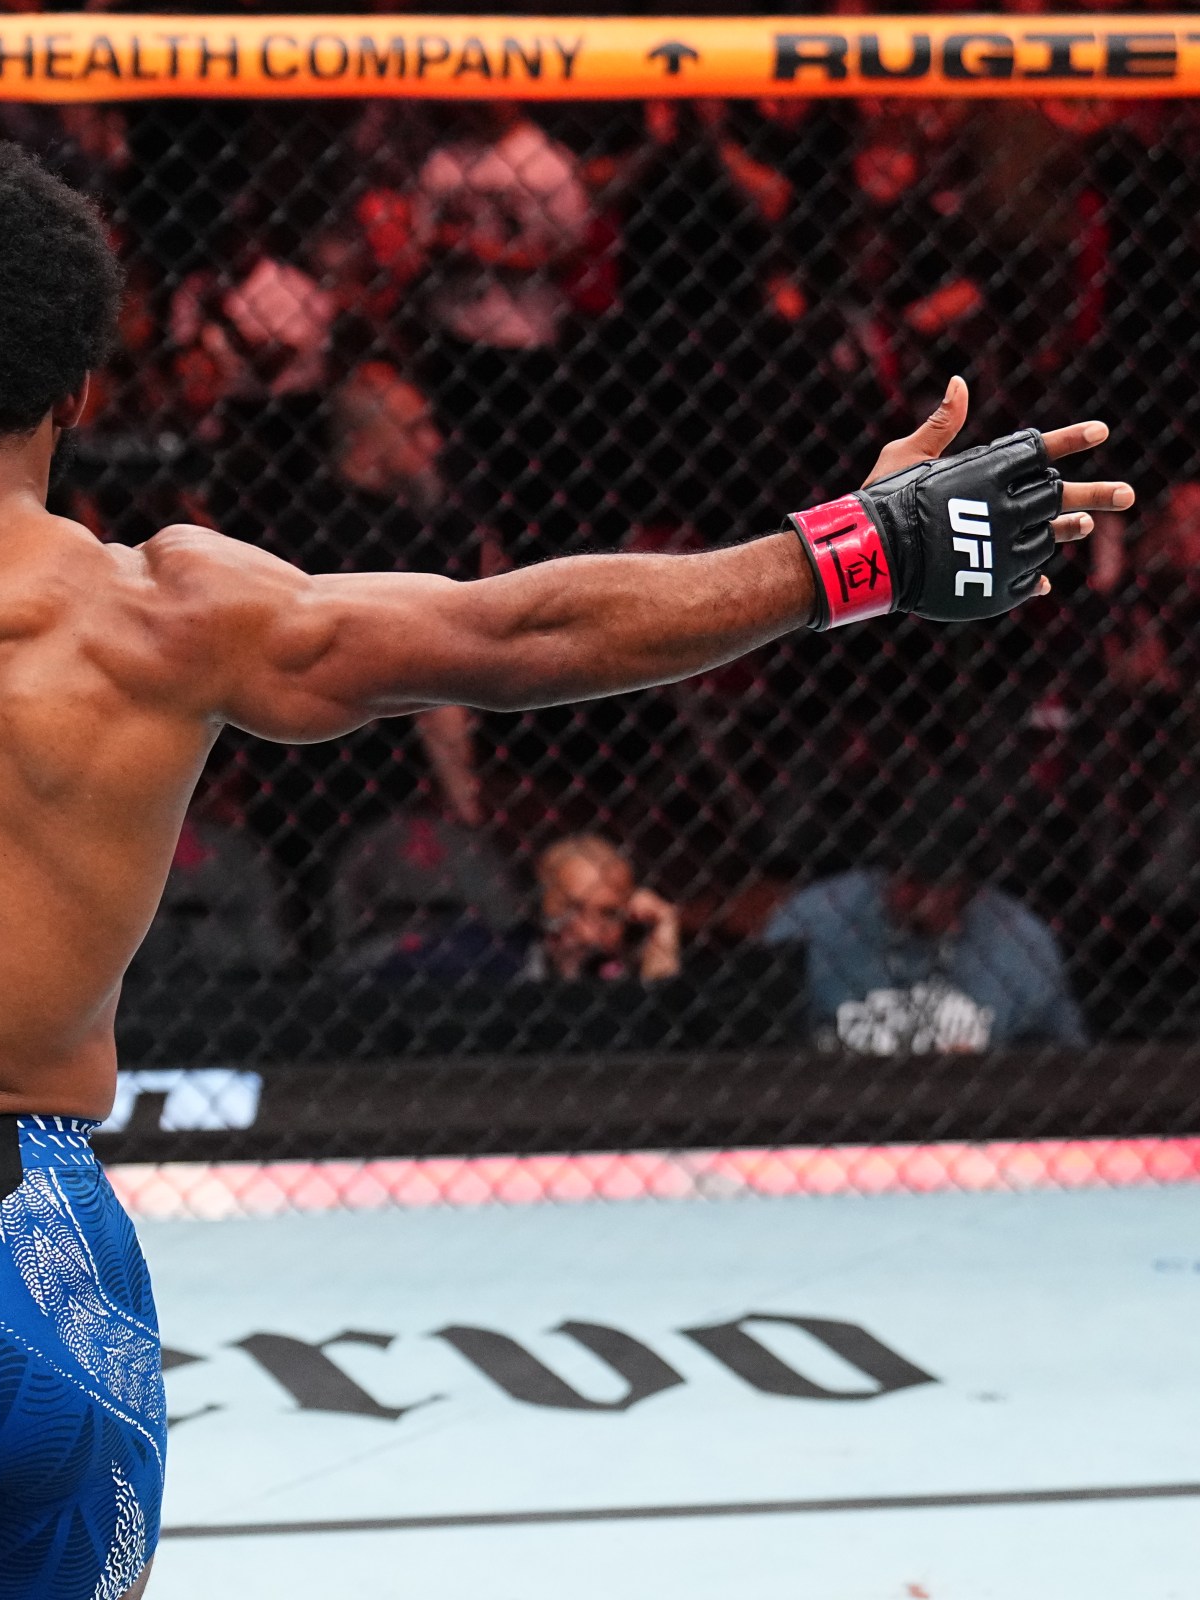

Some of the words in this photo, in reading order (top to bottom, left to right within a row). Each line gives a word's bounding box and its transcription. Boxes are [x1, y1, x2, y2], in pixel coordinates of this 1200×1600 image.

[258, 35, 584, 81] COMPANY
[773, 33, 1200, 80] RUGIE
[813, 523, 888, 603] TEX
[947, 498, 993, 597] UFC
